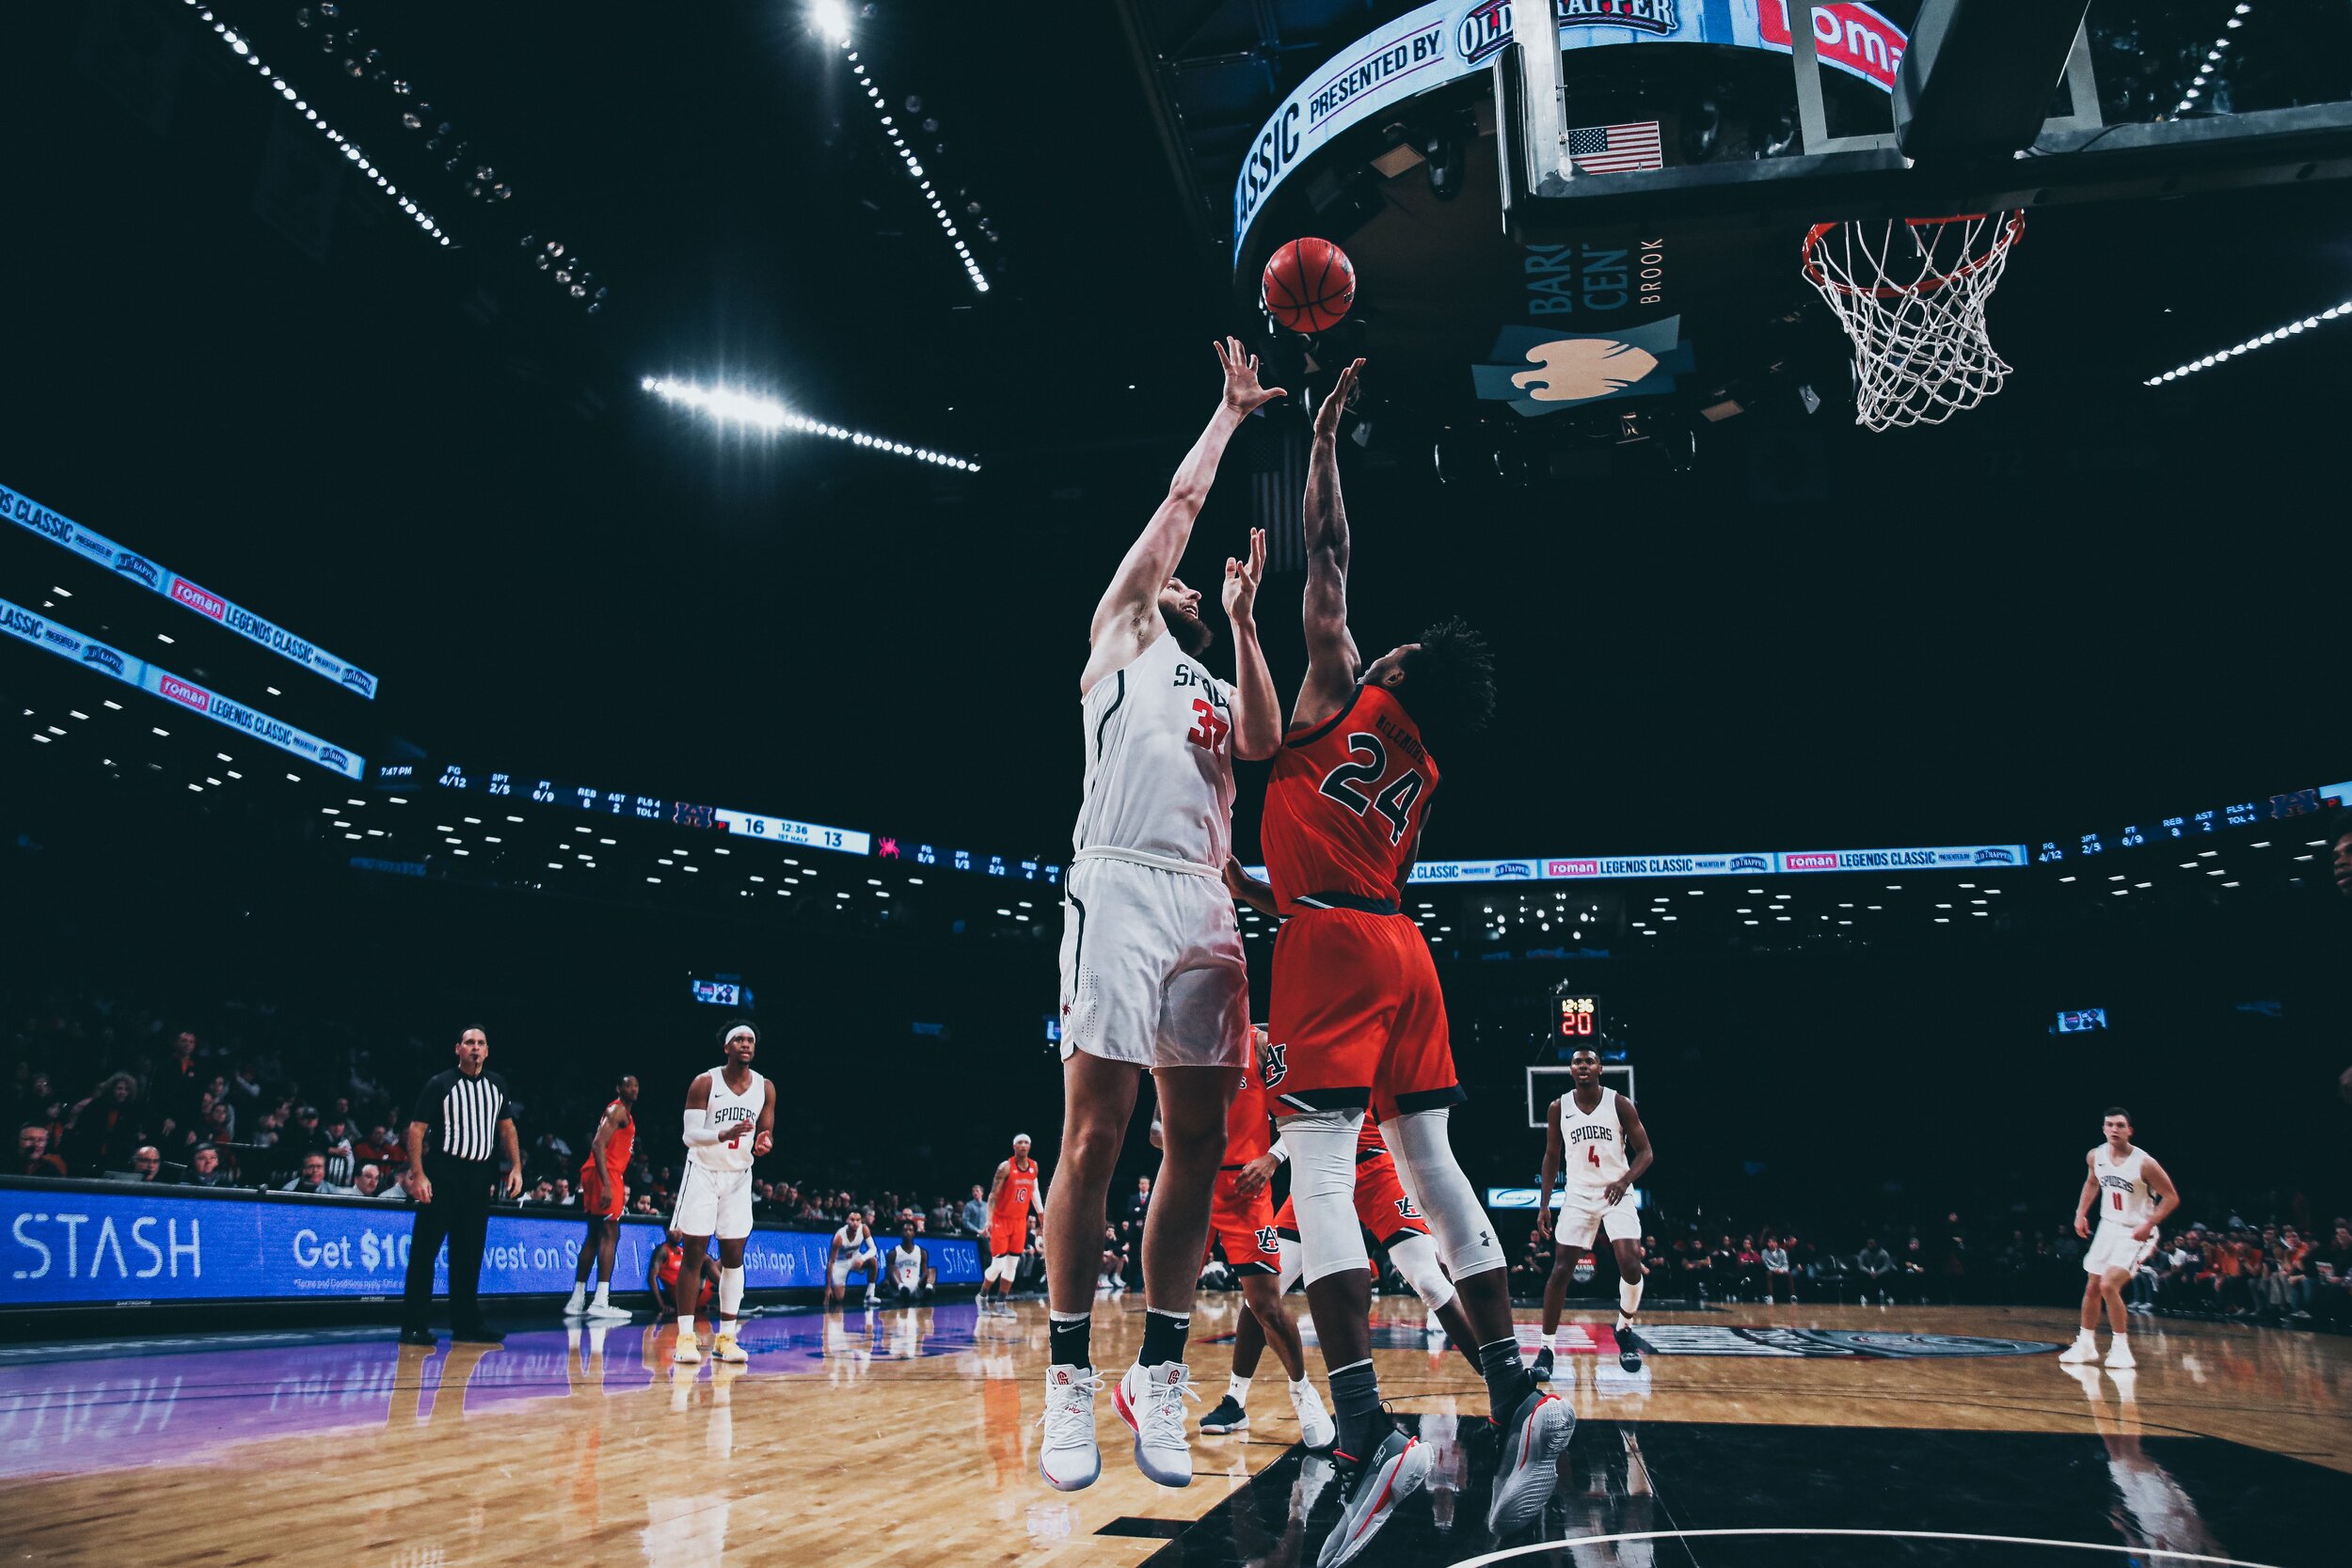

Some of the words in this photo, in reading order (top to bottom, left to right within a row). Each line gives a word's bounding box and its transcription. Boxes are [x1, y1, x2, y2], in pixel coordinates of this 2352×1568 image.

[1310, 44, 1407, 123] PRESENTED
[1413, 29, 1440, 62] BY
[1459, 3, 1513, 56] OLD
[1640, 238, 1664, 305] BROOK
[14, 499, 73, 543] CLASSIC
[176, 584, 221, 615] roman
[226, 605, 273, 643] LEGENDS
[273, 630, 314, 664] CLASSIC
[164, 681, 206, 706] roman
[210, 697, 254, 730] LEGENDS
[254, 717, 293, 746] CLASSIC
[398, 766, 413, 776] PM
[438, 774, 468, 788] 4/12
[489, 783, 511, 795] 2/5
[612, 802, 620, 814] 2
[636, 807, 653, 817] TOL
[653, 809, 660, 818] 4
[577, 787, 597, 799] REB
[608, 793, 626, 802] AST
[654, 800, 660, 808] 4
[1318, 731, 1424, 847] 24
[745, 817, 765, 835] 16
[781, 822, 808, 835] 12:36
[824, 831, 843, 847] 13
[2081, 833, 2098, 843] 3PT
[2124, 826, 2137, 834] FT
[2163, 816, 2184, 828] REB
[2195, 811, 2214, 821] AST
[2226, 804, 2245, 815] FLS
[2246, 802, 2254, 812] 4
[2038, 850, 2063, 863] 4/12
[2082, 842, 2103, 854] 2/5
[2122, 834, 2144, 847] 6/9
[2202, 821, 2212, 832] 2
[2228, 816, 2246, 825] TOL
[2247, 814, 2256, 822] 4
[1552, 862, 1595, 874] roman
[1600, 859, 1647, 874] LEGENDS
[1649, 858, 1693, 873] CLASSIC
[1789, 856, 1835, 867] roman
[1839, 852, 1888, 867] LEGENDS
[1890, 850, 1937, 865] CLASSIC
[1025, 871, 1033, 880] 4
[1048, 875, 1056, 883] 4
[1417, 864, 1460, 879] CLASSIC
[1562, 998, 1595, 1013] 12:36
[1562, 1011, 1592, 1035] 20
[715, 1106, 756, 1125] SPIDERS
[1570, 1125, 1613, 1145] SPIDERS
[1587, 1145, 1600, 1167] 4
[2100, 1175, 2135, 1194] SPIDERS
[2112, 1192, 2123, 1212] 11
[13, 1212, 202, 1279] STASH
[293, 1227, 354, 1270] Get
[533, 1246, 561, 1270] on
[943, 1246, 978, 1275] STASH
[906, 1268, 912, 1278] 2
